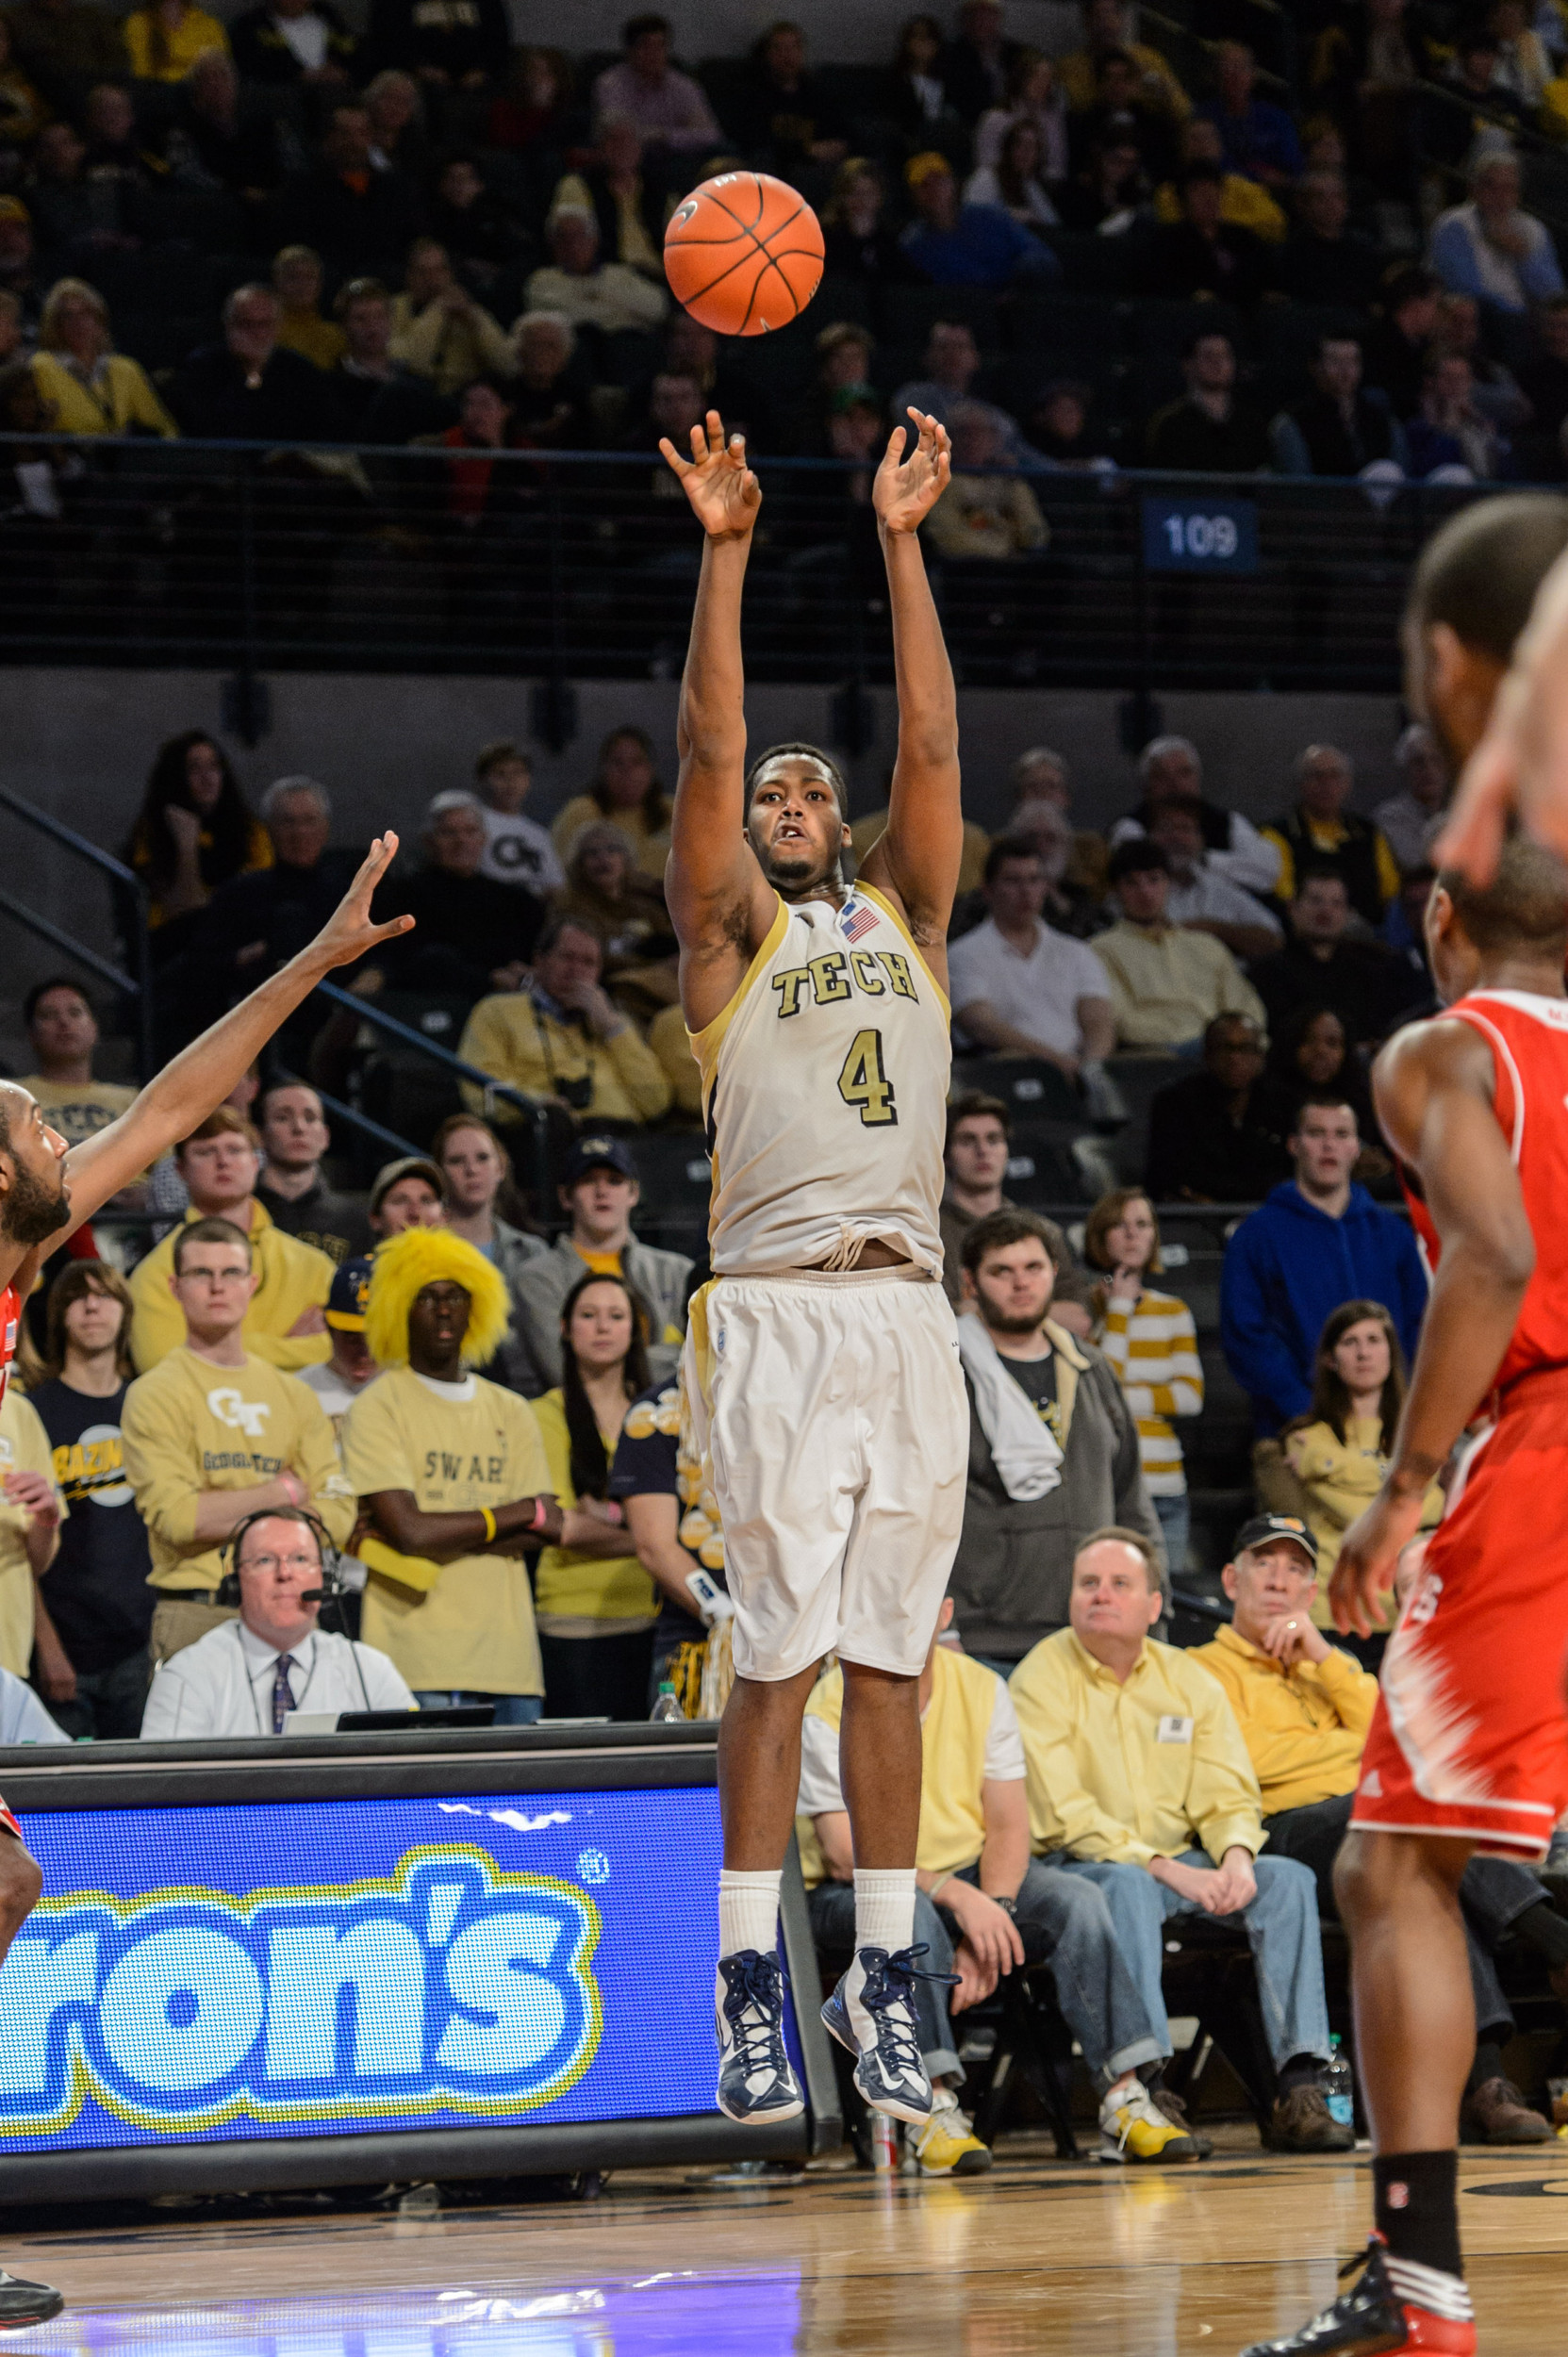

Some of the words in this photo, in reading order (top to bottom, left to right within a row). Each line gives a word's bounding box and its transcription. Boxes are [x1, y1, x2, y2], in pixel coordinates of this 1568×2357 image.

[1164, 513, 1238, 558] 109
[772, 951, 919, 1018] TECH
[837, 1029, 899, 1128] 4
[206, 1387, 271, 1437] GT
